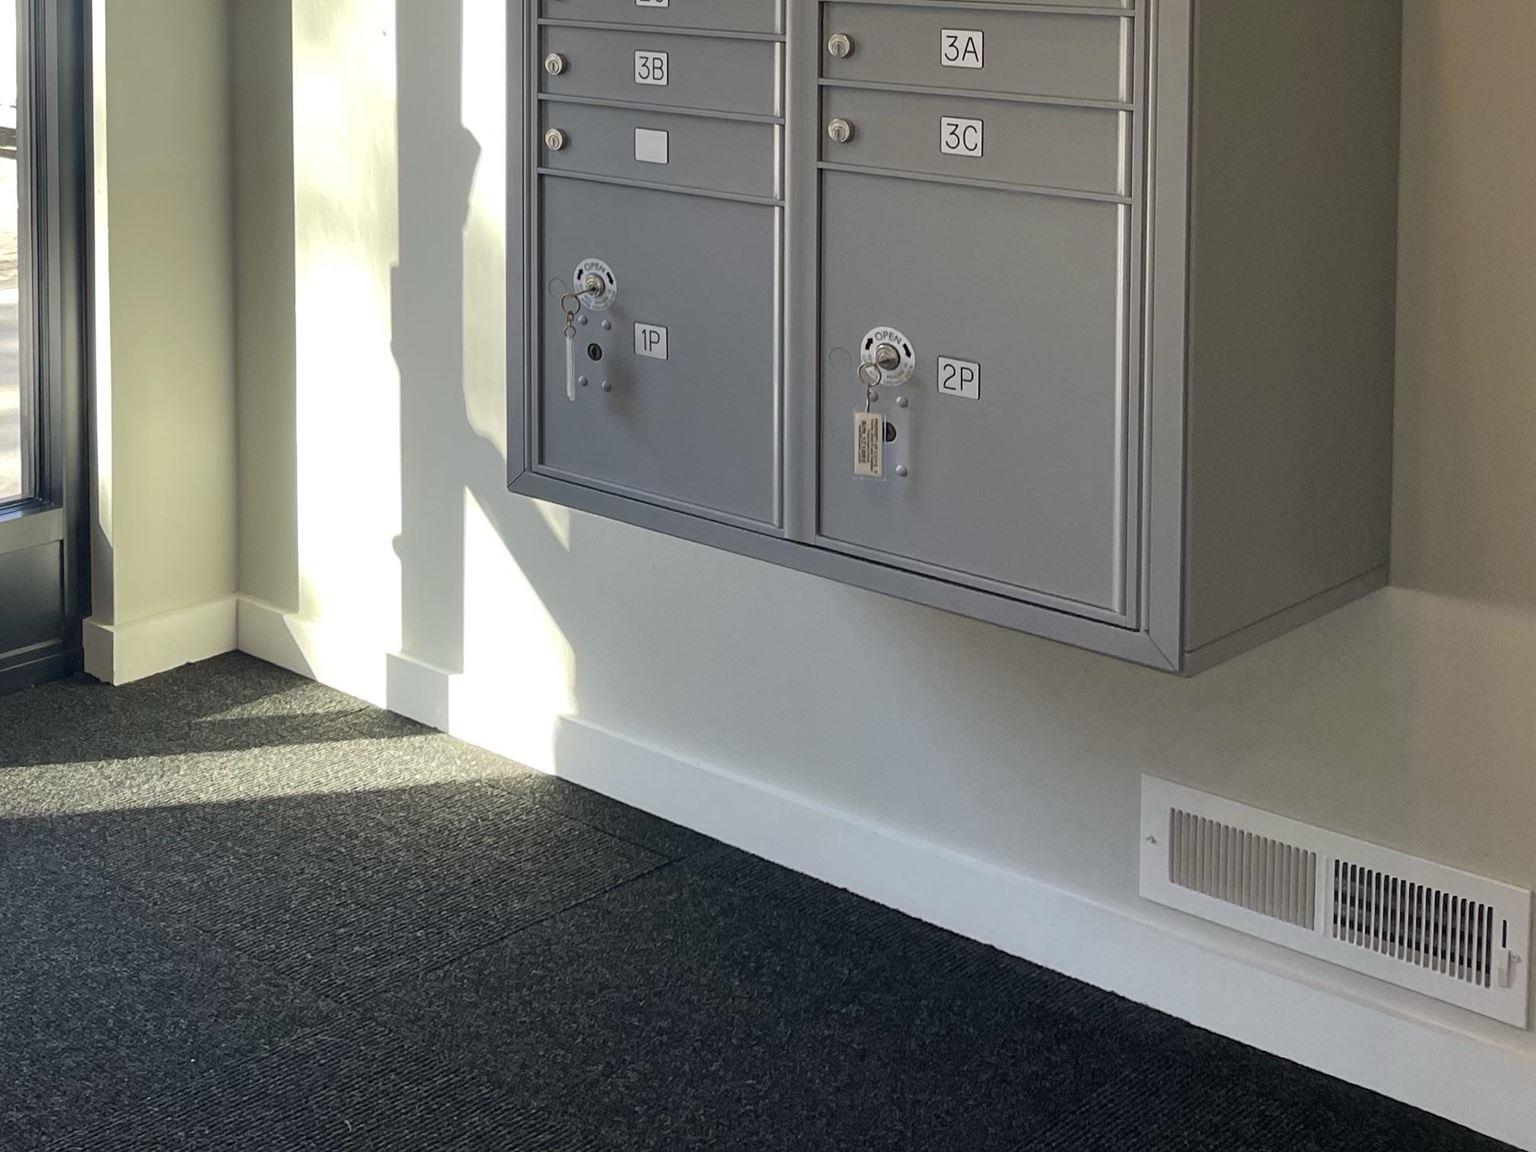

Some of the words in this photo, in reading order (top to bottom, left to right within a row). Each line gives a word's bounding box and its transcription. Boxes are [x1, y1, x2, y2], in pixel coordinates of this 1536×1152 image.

[944, 35, 980, 63] 3A
[638, 56, 665, 81] 3B
[945, 123, 978, 151] 3C
[584, 262, 606, 272] OPEN
[641, 328, 661, 352] 1P
[874, 330, 902, 344] OPEN
[943, 363, 974, 391] 2P
